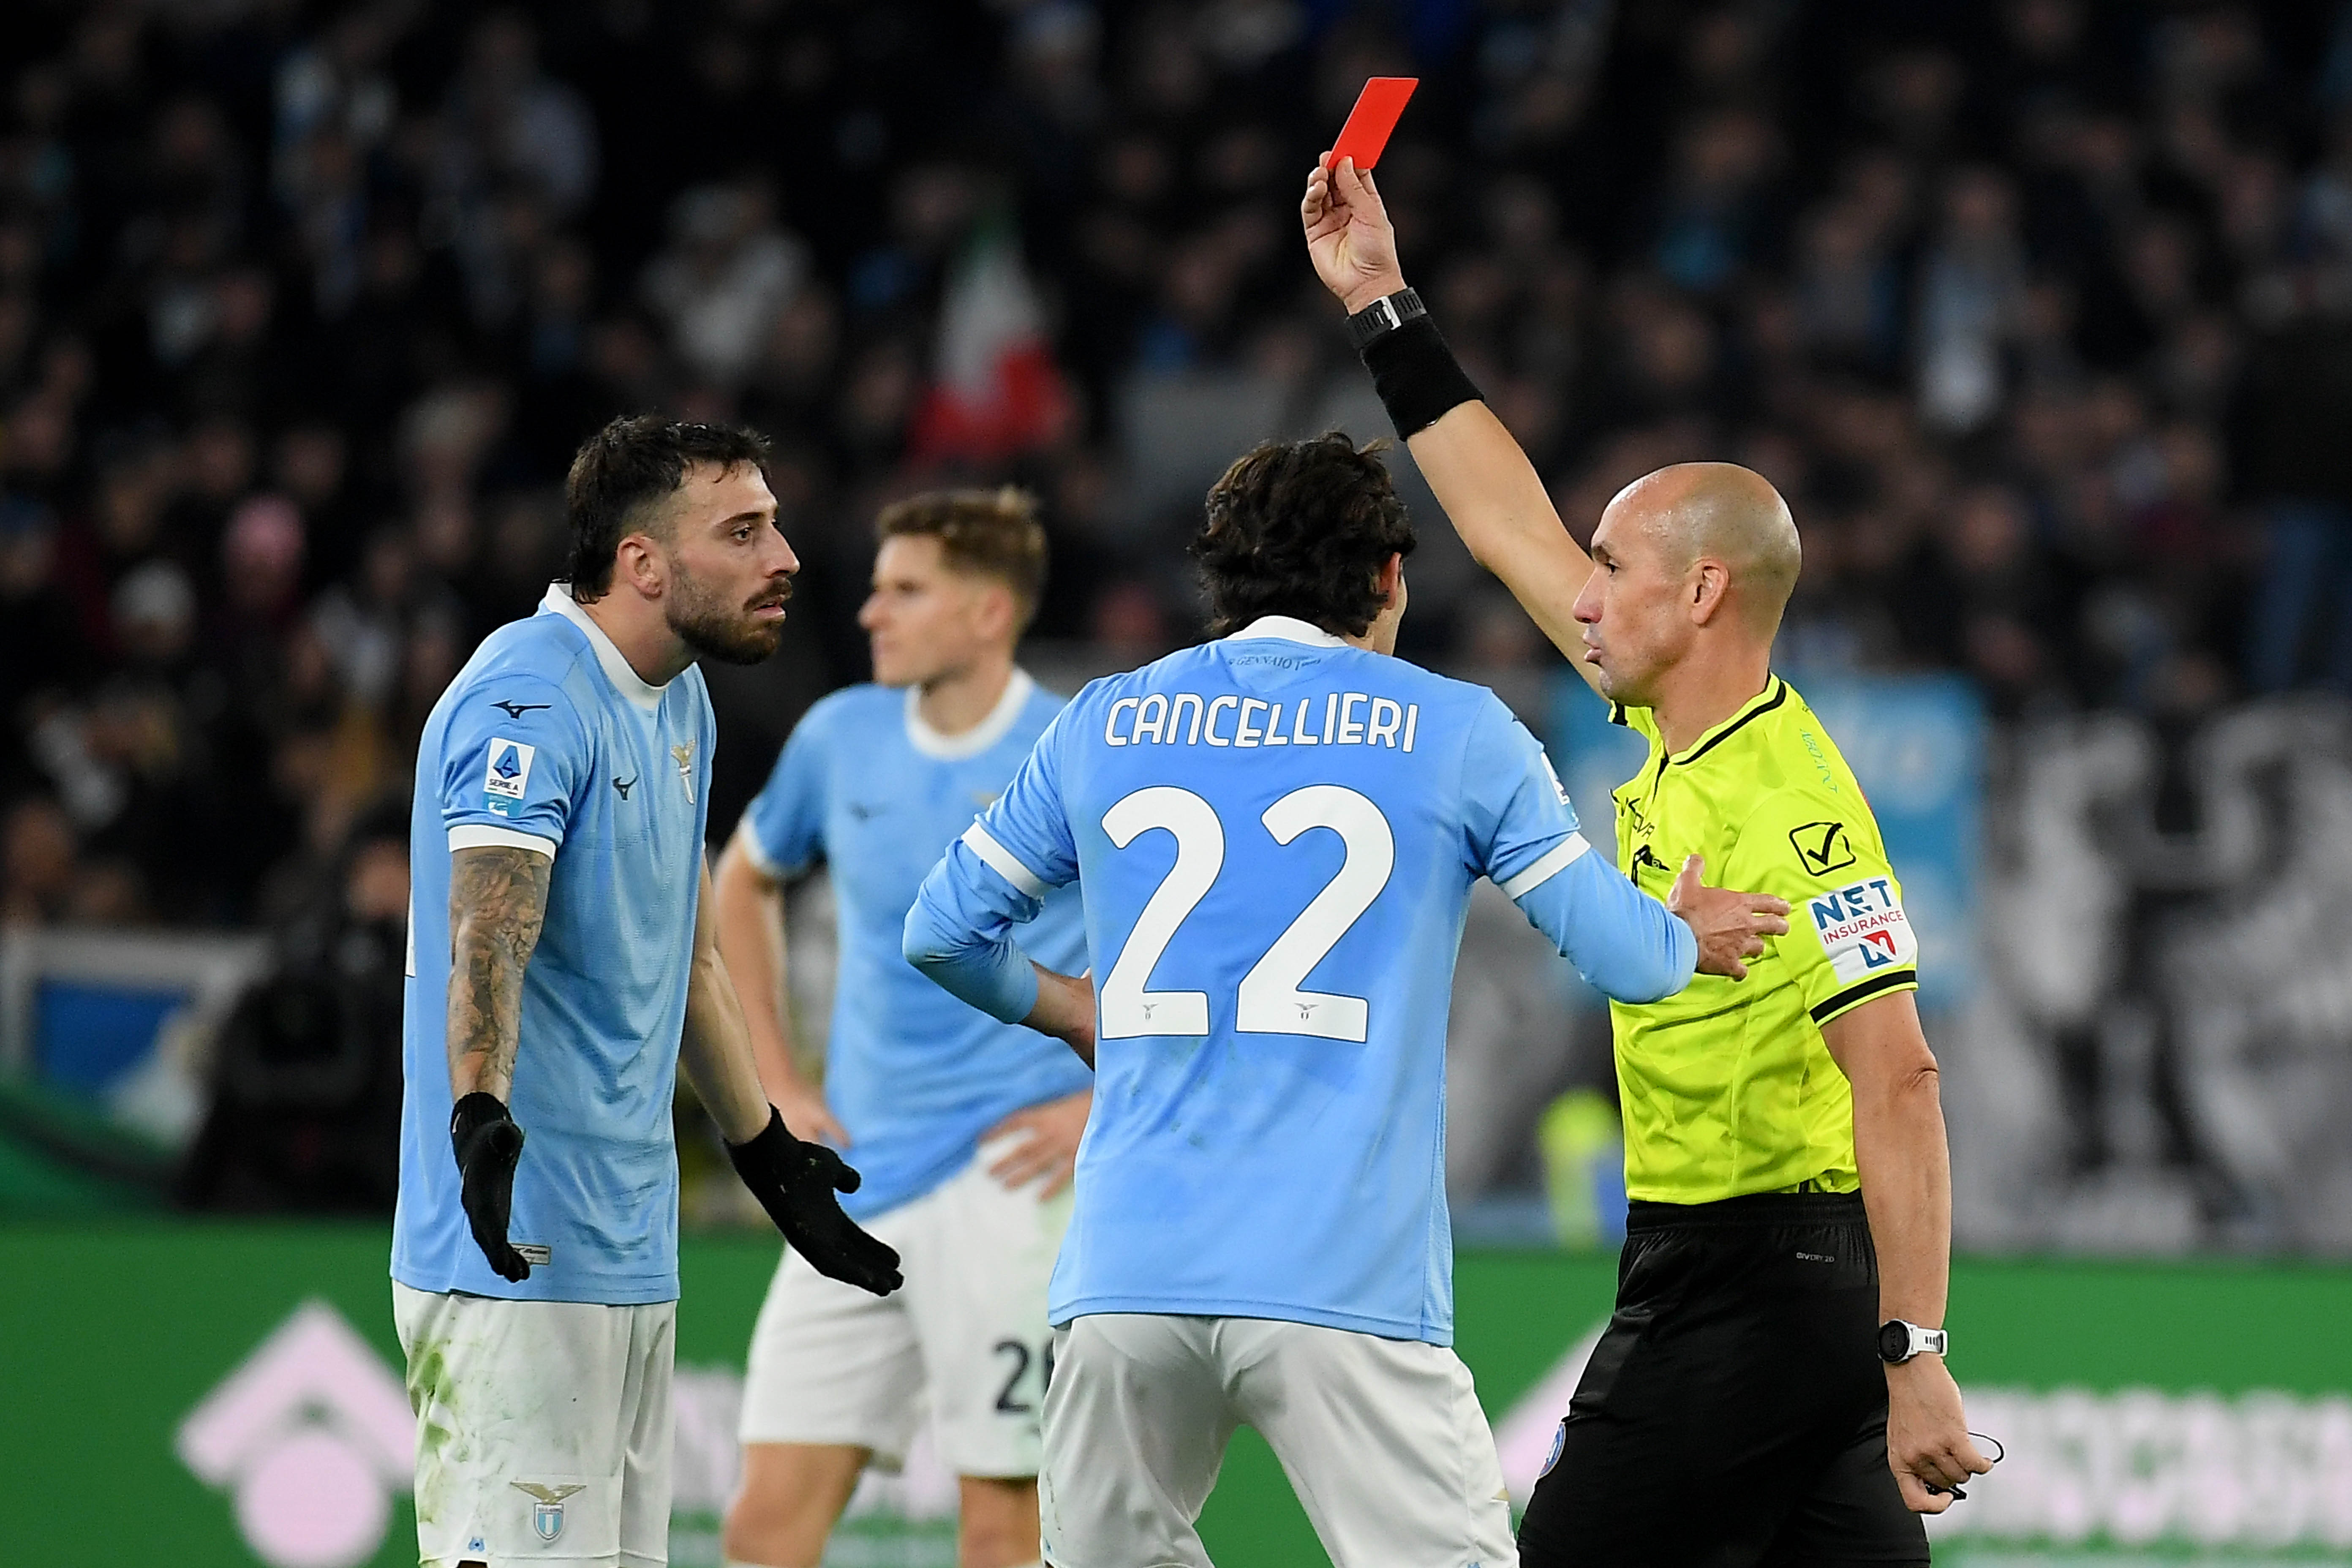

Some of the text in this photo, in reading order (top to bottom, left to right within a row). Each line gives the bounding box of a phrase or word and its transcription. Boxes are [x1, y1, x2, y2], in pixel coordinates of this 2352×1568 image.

[1105, 693, 1419, 753] CANCELLIERI
[1100, 784, 1395, 1043] 22
[1811, 879, 1892, 930] NET
[1823, 910, 1904, 945] INSURANCE
